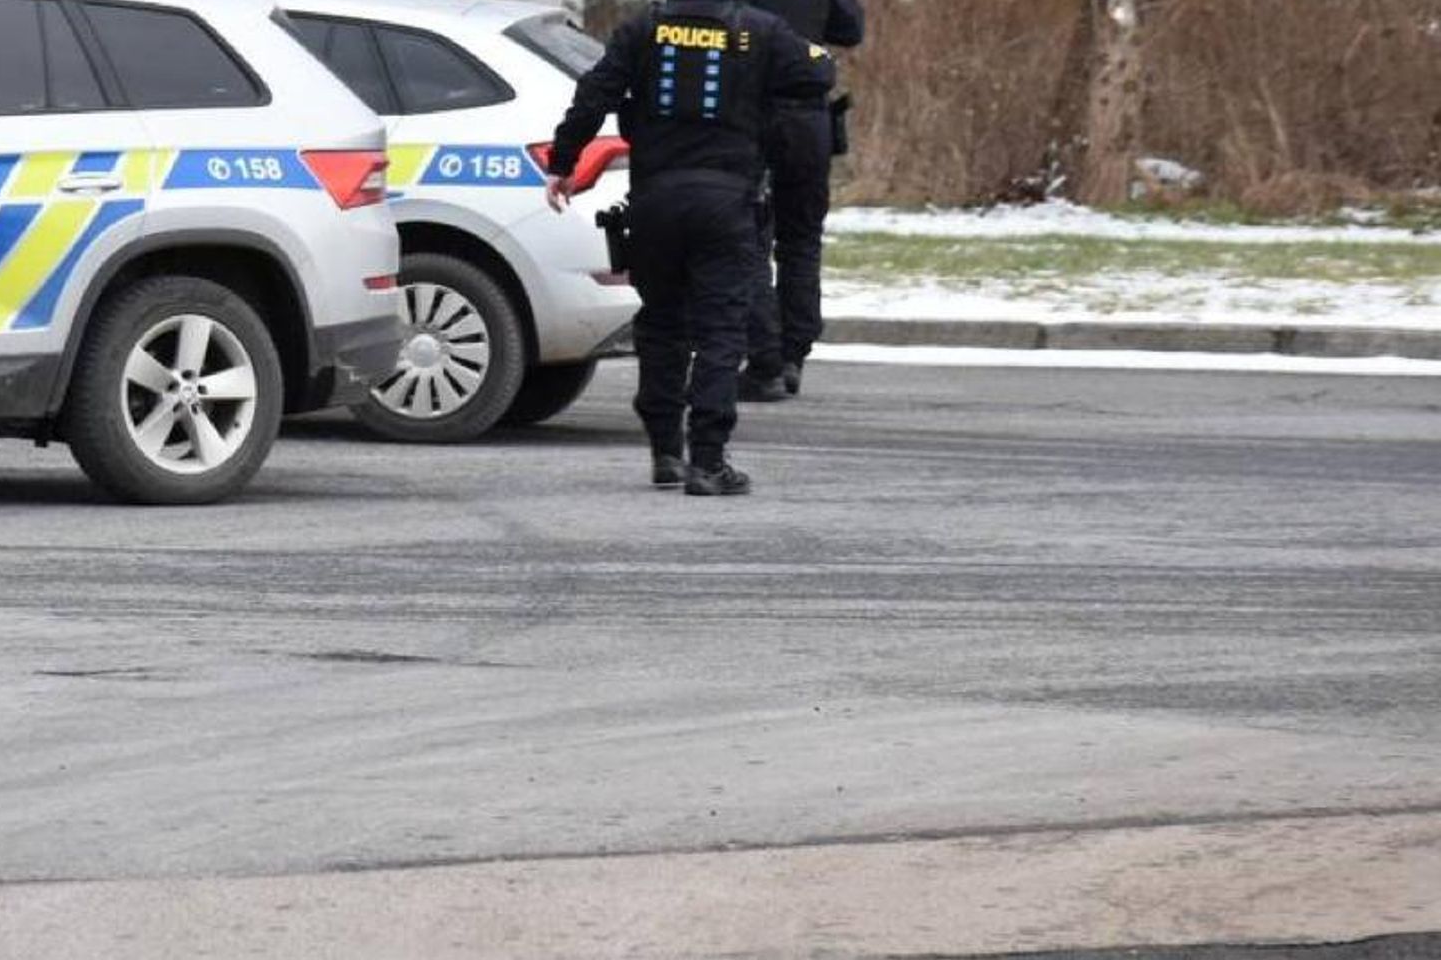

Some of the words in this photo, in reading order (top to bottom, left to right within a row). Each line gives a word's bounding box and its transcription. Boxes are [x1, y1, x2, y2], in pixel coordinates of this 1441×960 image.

[656, 24, 728, 50] POLICIE
[234, 157, 283, 180] 158
[470, 155, 522, 178] 158
